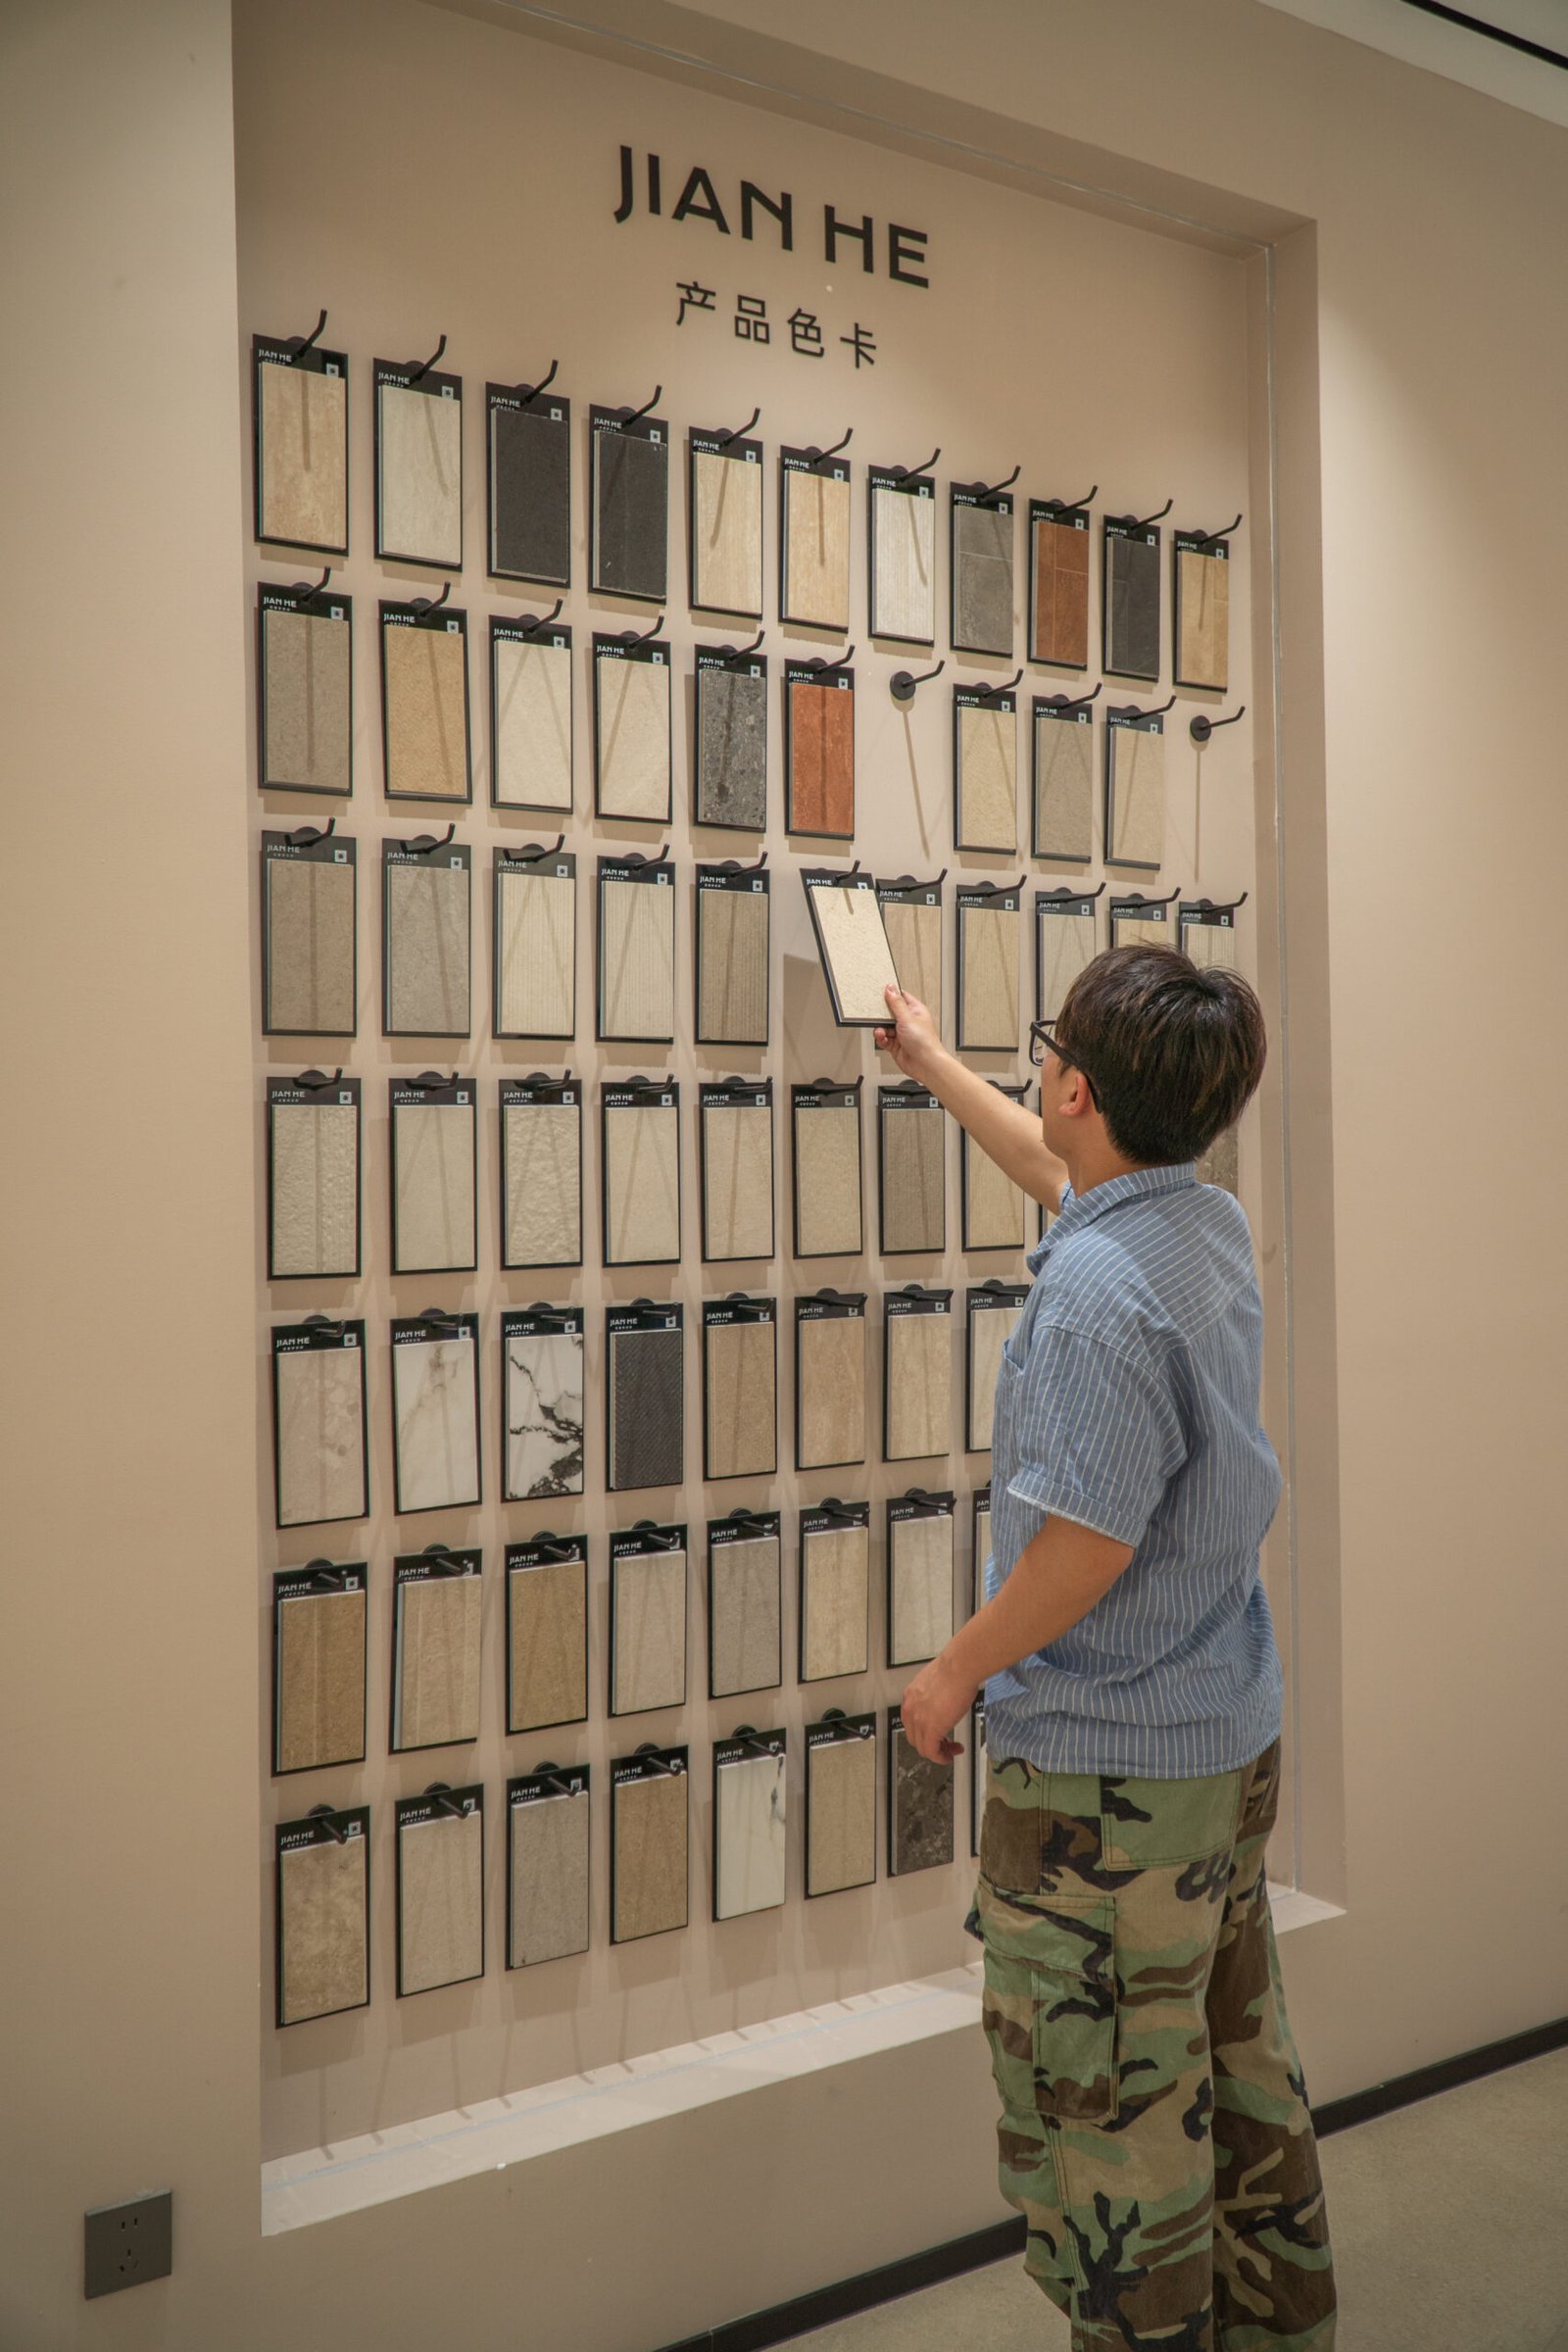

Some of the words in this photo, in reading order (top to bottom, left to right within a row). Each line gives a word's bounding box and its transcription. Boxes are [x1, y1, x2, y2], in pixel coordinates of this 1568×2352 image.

[613, 145, 793, 252] JIAN
[824, 204, 929, 289] HE
[675, 280, 877, 369] 产品色卡
[259, 349, 277, 360] JIAN
[378, 372, 397, 382] JIAN
[491, 396, 508, 405] JIAN
[594, 417, 611, 426] JIAN
[396, 1331, 413, 1340] JIAN
[276, 1339, 295, 1348] JIAN
[711, 1531, 727, 1540] JIAN
[510, 1555, 526, 1565] JIAN
[399, 1569, 416, 1578] JIAN
[278, 1585, 297, 1593] JIAN
[717, 1751, 732, 1760] JIAN
[614, 1769, 630, 1778] JIAN
[512, 1789, 527, 1799] JIAN
[400, 1810, 418, 1821] JIAN
[281, 1834, 300, 1845] JIAN
